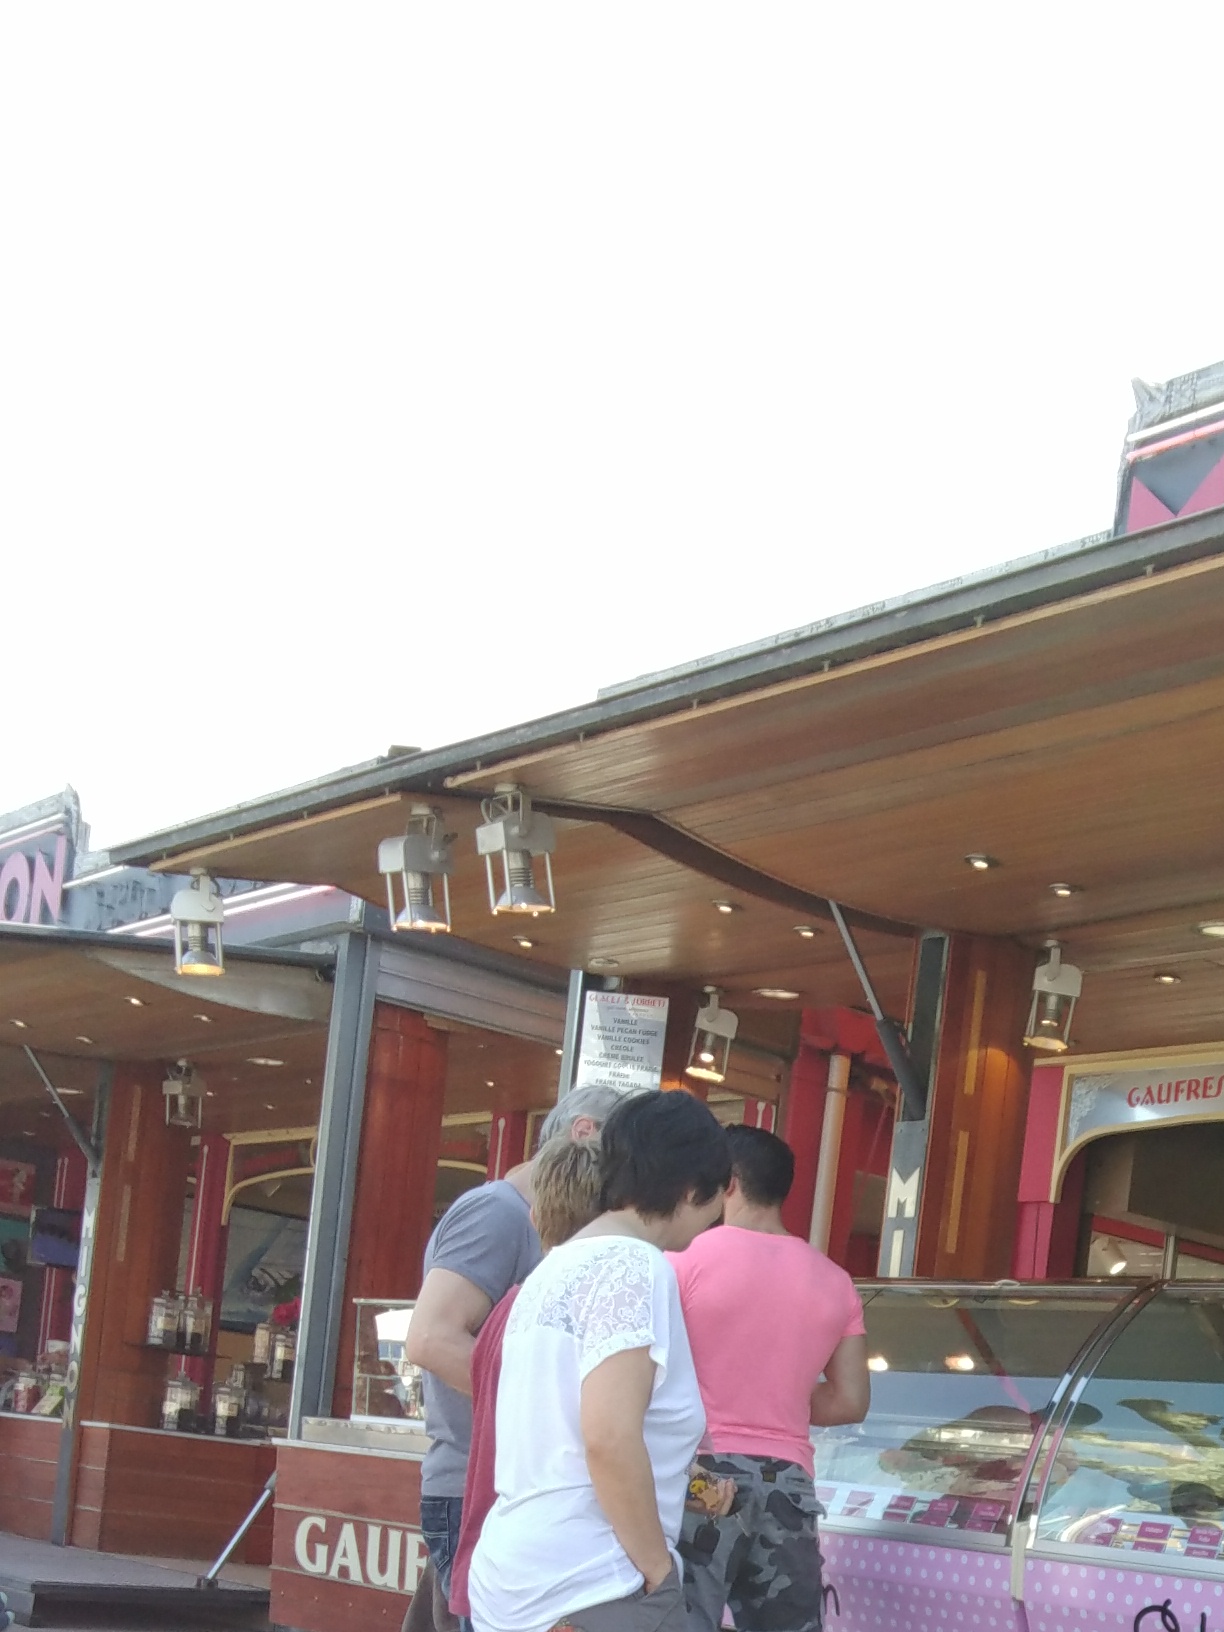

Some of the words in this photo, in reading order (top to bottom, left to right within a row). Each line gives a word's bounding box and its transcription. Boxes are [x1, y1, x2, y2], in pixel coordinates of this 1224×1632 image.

[614, 1017, 637, 1026] VANILLE
[591, 1024, 615, 1033] VANILLE
[597, 1034, 621, 1042] VANILLE
[62, 1205, 97, 1432] MIGNON
